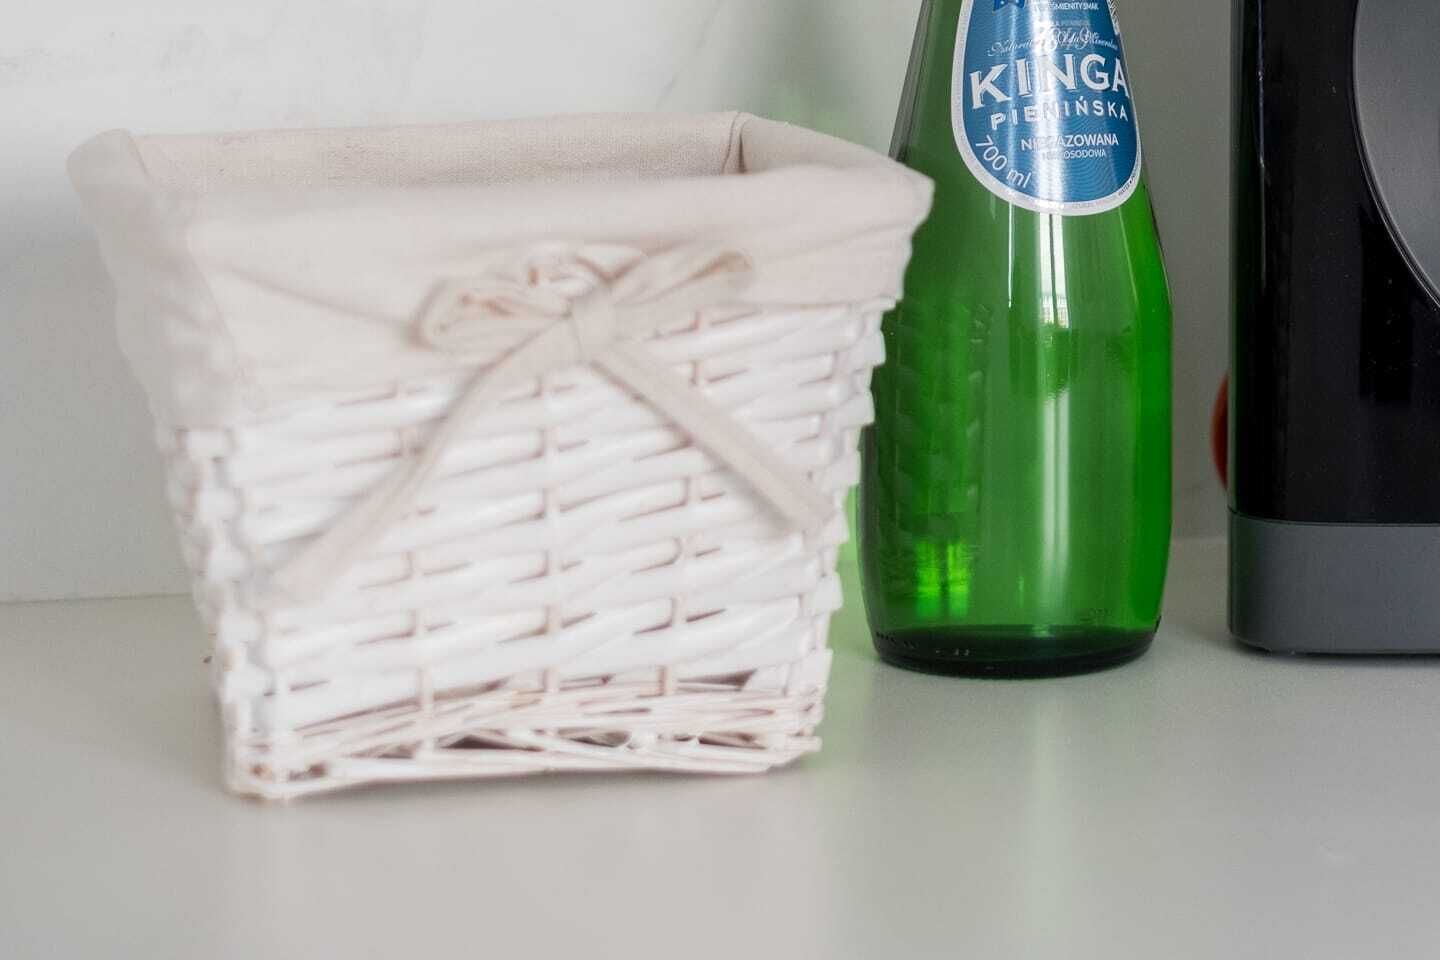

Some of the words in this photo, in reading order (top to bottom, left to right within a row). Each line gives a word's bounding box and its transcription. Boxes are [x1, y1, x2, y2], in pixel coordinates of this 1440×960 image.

[970, 53, 1130, 110] KINGA
[991, 95, 1129, 131] PIENIŃSKA
[976, 135, 1008, 172] 700
[1006, 168, 1032, 189] ml
